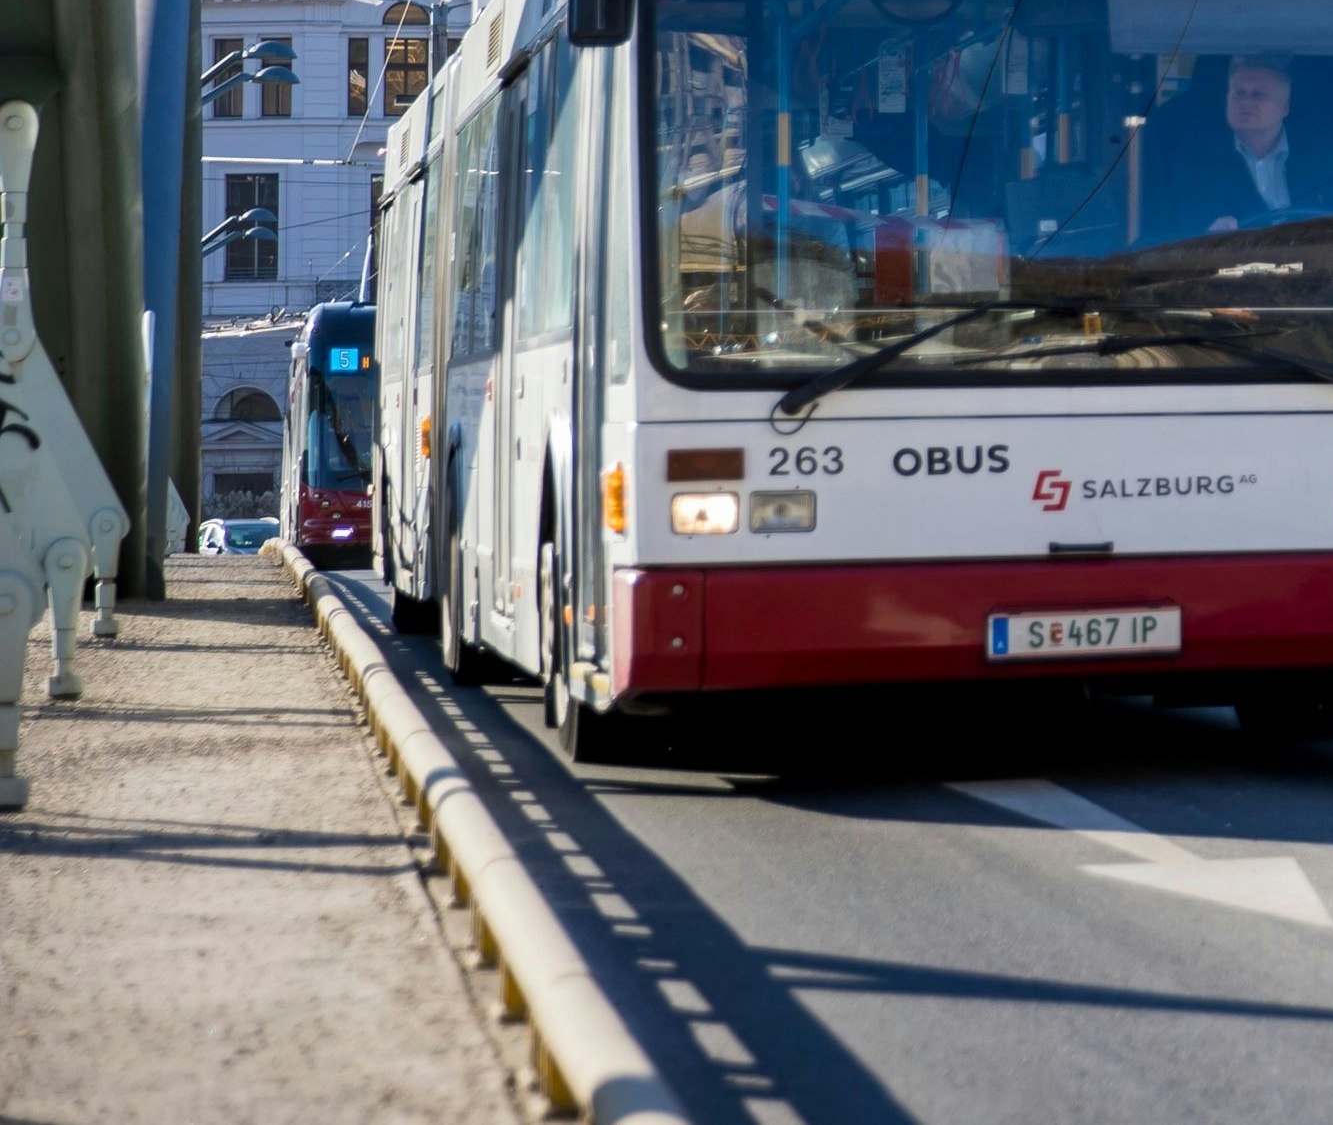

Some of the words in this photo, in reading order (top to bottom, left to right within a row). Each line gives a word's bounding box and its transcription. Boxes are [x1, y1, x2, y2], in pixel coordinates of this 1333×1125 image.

[340, 350, 350, 368] 5
[768, 446, 845, 476] 263
[892, 444, 1011, 477] OBUS
[1082, 475, 1235, 499] SALZBURG
[1239, 474, 1259, 485] AG
[1028, 620, 1045, 649] S
[1068, 617, 1120, 647] 467
[1131, 615, 1158, 644] IP
